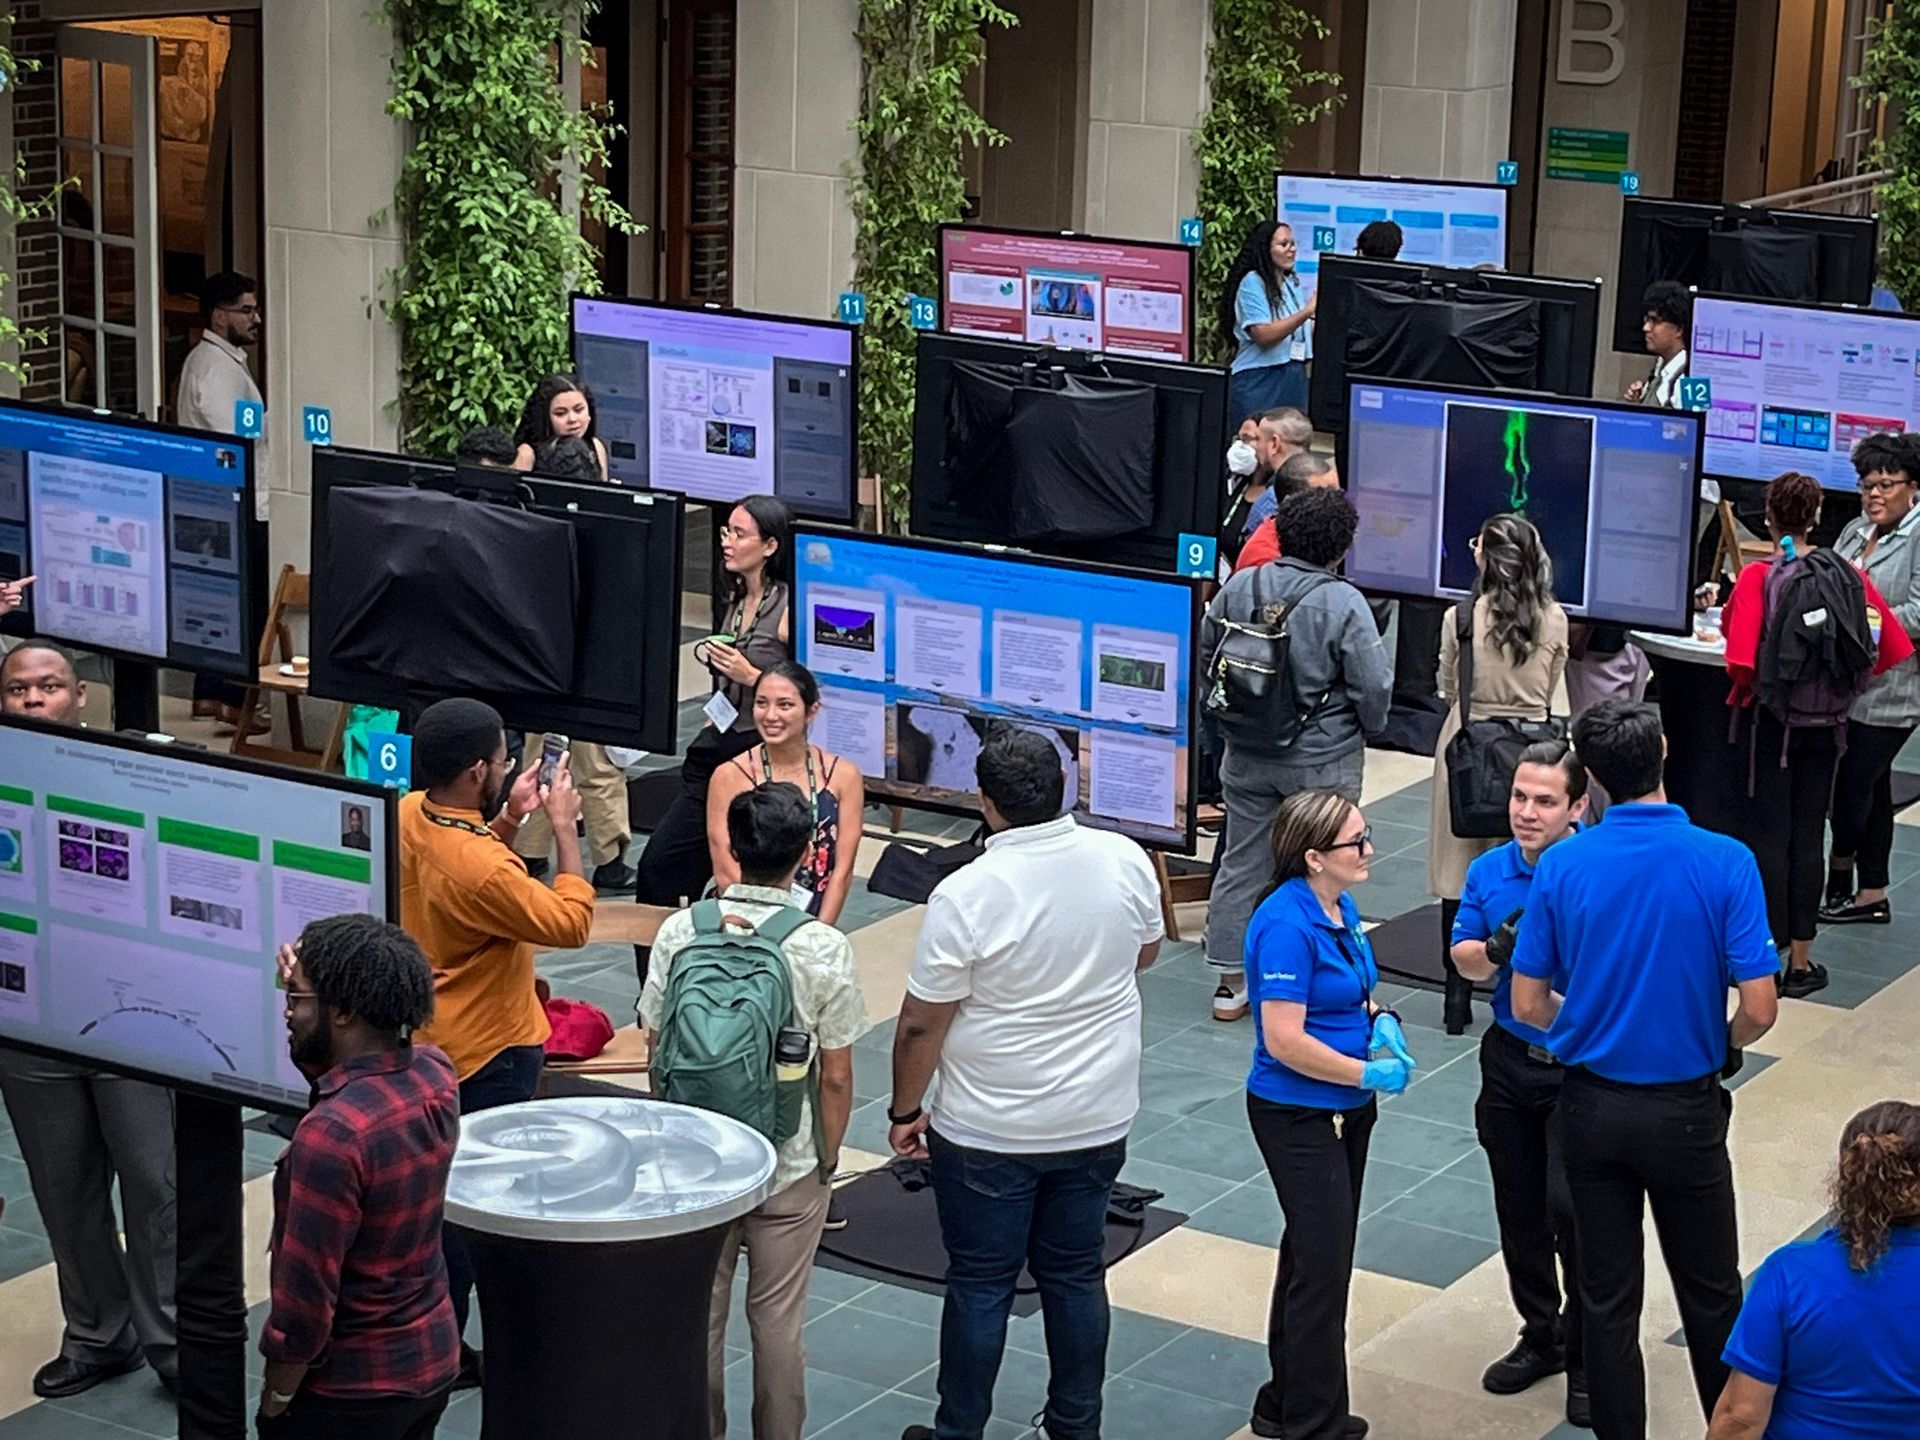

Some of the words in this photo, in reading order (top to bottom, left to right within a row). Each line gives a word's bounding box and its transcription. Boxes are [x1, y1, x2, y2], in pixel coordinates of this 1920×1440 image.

[1557, 0, 1625, 84] B
[1499, 166, 1515, 179] 17
[1623, 175, 1639, 190] 19
[1182, 223, 1199, 239] 14
[1316, 231, 1334, 245] 16
[842, 298, 860, 315] 11
[915, 304, 934, 321] 13
[1683, 383, 1707, 402] 12
[242, 407, 255, 427] 8
[306, 413, 330, 434] 10
[1188, 543, 1204, 566] 9
[380, 743, 397, 771] 6
